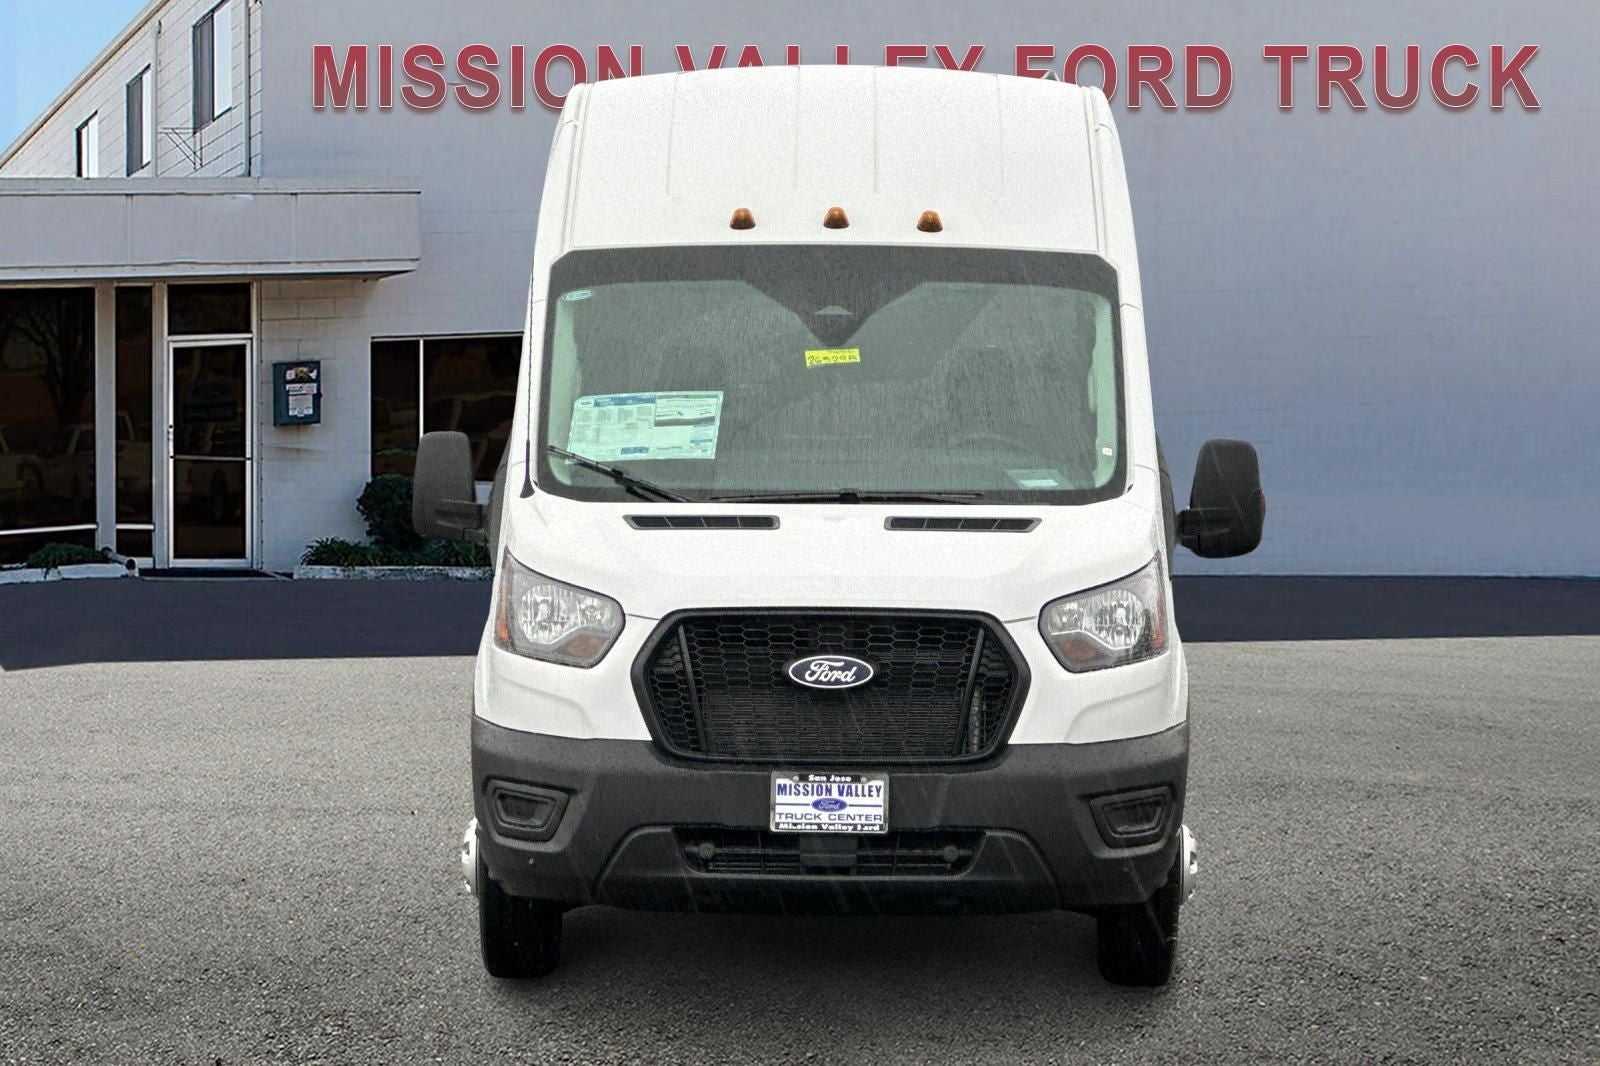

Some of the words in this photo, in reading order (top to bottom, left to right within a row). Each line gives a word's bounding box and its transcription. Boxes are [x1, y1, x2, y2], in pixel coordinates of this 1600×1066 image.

[312, 44, 643, 109] MISSION
[1015, 43, 1233, 108] FORD
[1264, 43, 1541, 109] TRUCK
[804, 660, 857, 682] Ford
[777, 783, 832, 796] MISSION
[837, 784, 882, 797] VALLEY
[818, 800, 840, 809] Ford
[776, 812, 822, 821] TRUCK
[828, 813, 882, 821] CENTER
